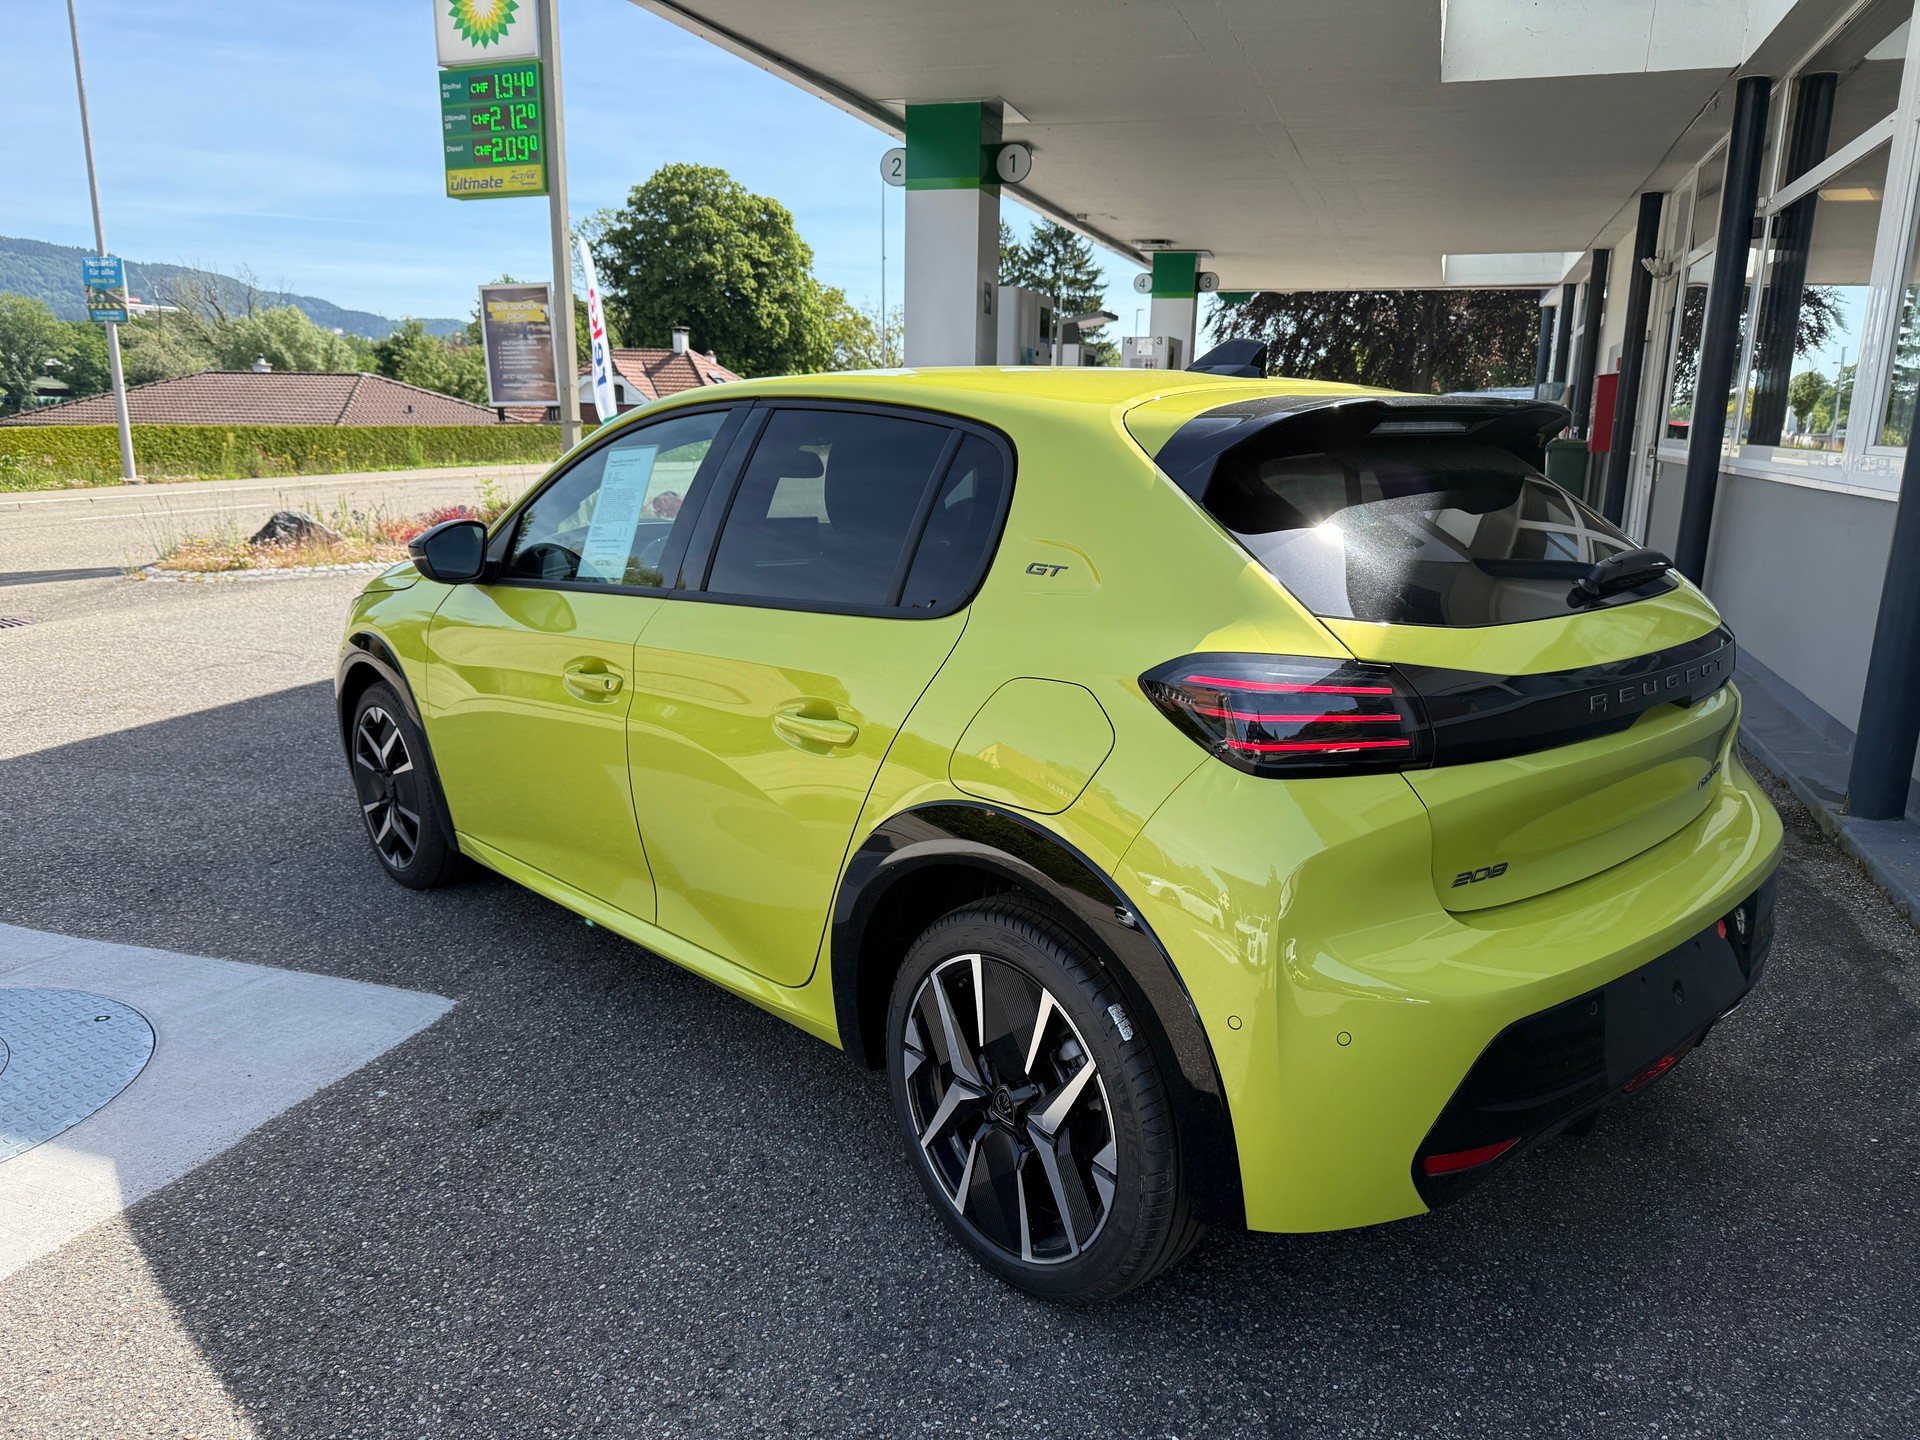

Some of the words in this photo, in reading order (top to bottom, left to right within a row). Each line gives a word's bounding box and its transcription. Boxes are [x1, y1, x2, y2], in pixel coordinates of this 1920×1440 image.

[470, 82, 489, 94] CHF
[472, 113, 490, 125] CHF
[474, 145, 492, 156] CHF
[891, 157, 902, 177] 2
[1008, 153, 1016, 173] 1
[451, 175, 504, 191] ultimate
[89, 268, 99, 276] für
[101, 268, 115, 276] alle
[1139, 278, 1146, 289] 4
[1204, 277, 1212, 289] 3
[510, 303, 538, 311] SUCHEN
[1126, 337, 1133, 345] 4
[1156, 336, 1163, 345] 3
[1025, 562, 1069, 577] GT
[1590, 656, 1725, 714] PEUGEOT
[1451, 862, 1508, 888] 208
